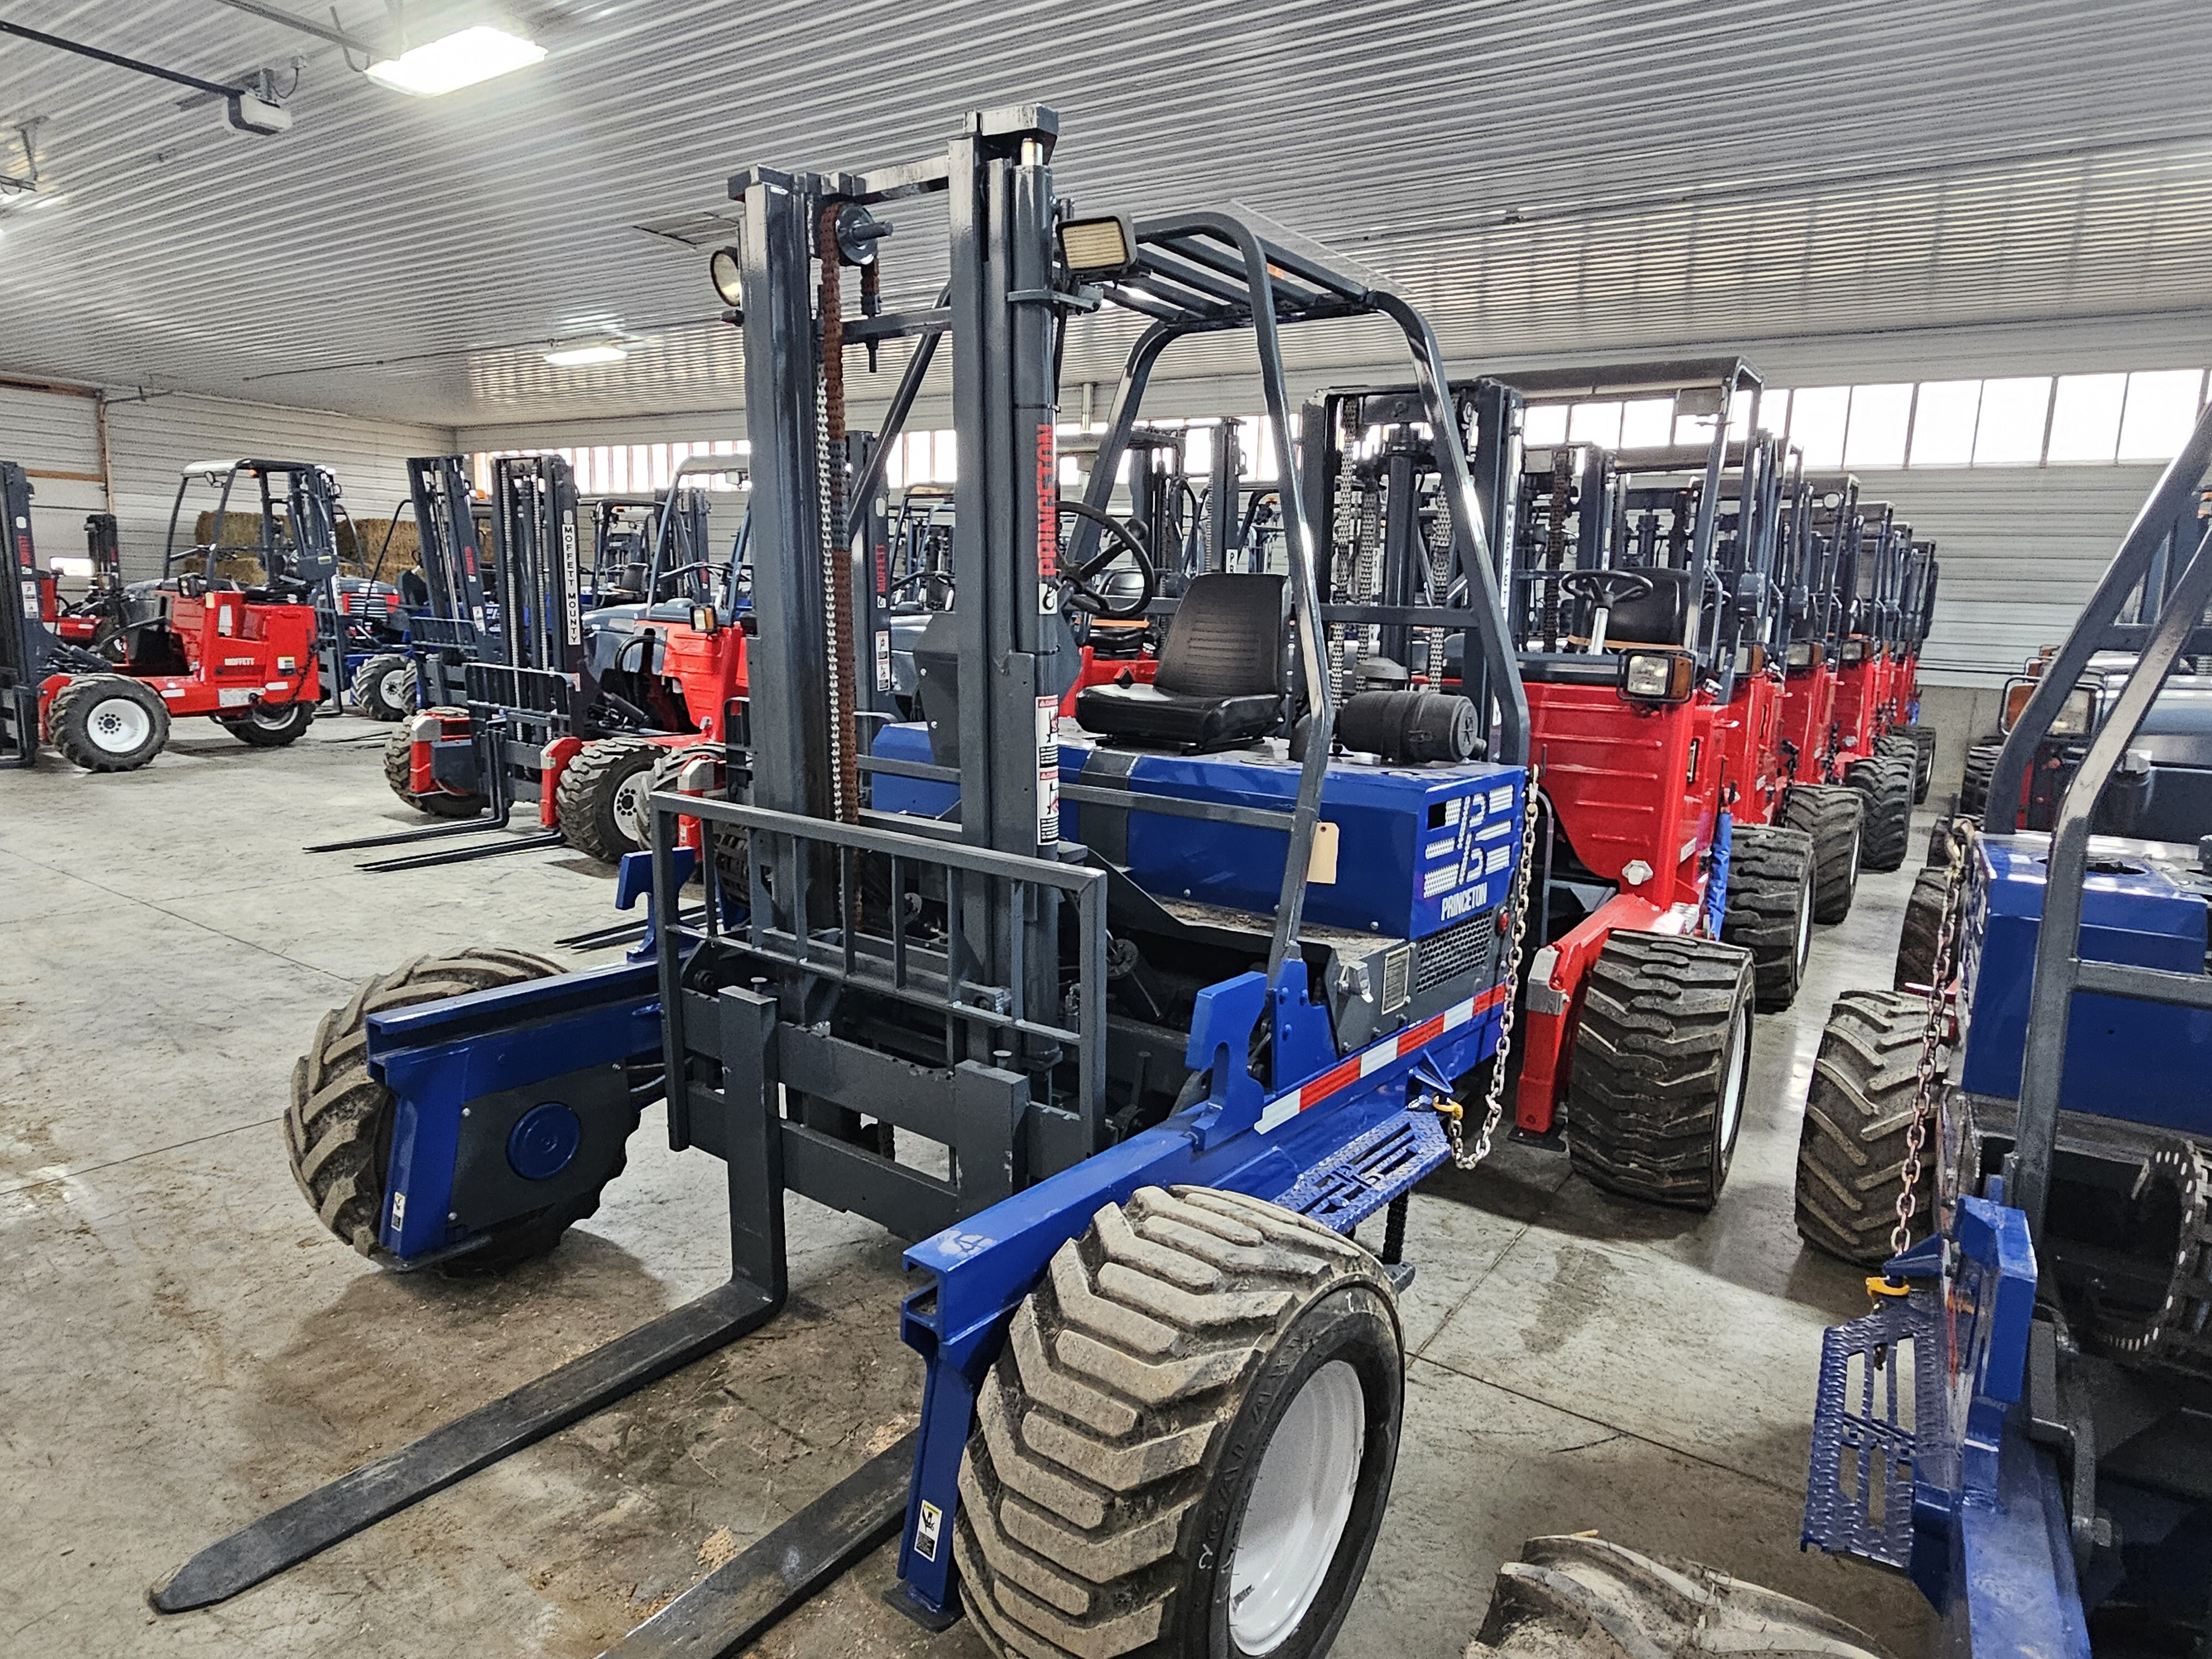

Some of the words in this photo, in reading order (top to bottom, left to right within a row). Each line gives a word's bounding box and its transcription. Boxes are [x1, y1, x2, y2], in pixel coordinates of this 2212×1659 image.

[1036, 424, 1057, 576] PRINCETON
[564, 526, 576, 587] MOFFETT
[567, 592, 578, 643] MOUNTY
[1441, 882, 1488, 921] PRINCETON
